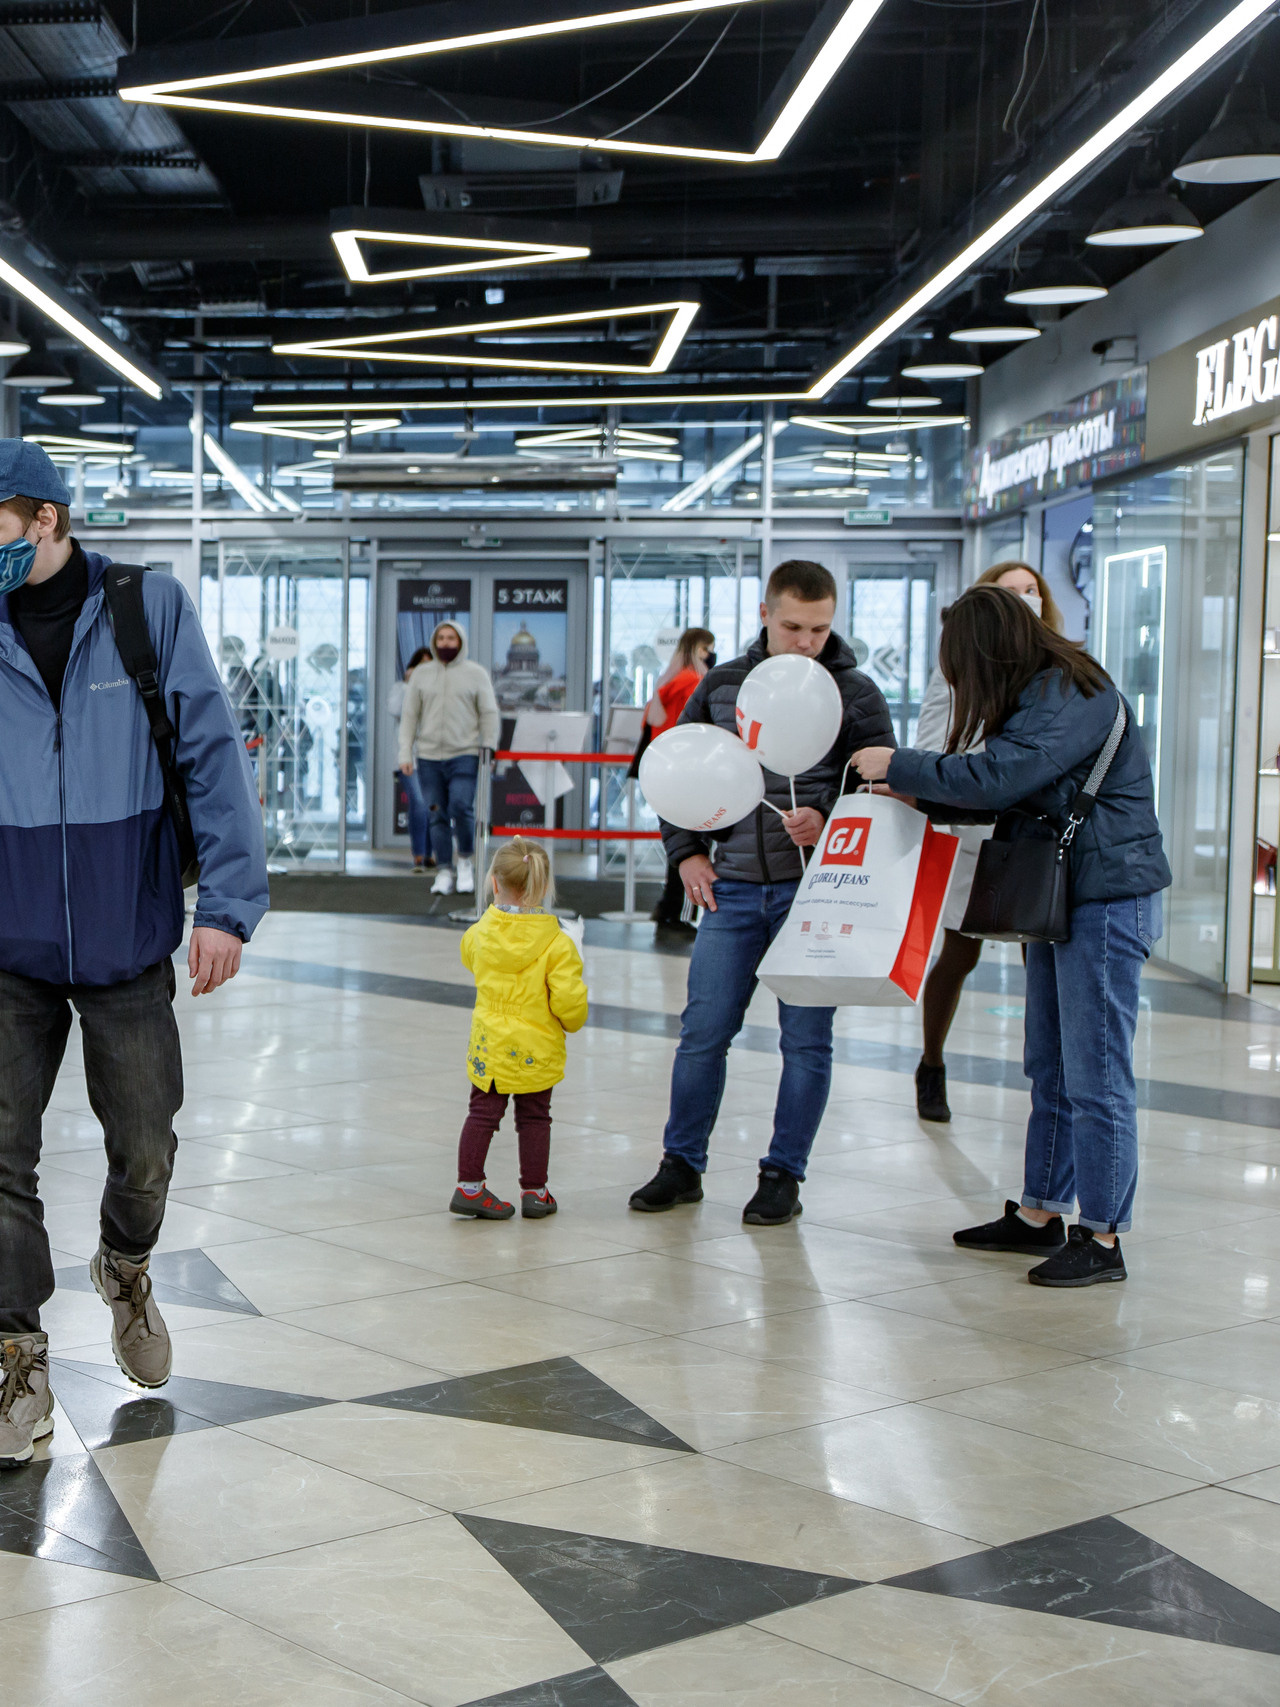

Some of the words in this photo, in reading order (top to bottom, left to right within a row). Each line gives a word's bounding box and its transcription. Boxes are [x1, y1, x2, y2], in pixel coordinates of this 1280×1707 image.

[1192, 314, 1280, 427] ELEG
[1050, 408, 1116, 484] красоты
[497, 589, 510, 604] 5
[513, 588, 564, 604] ЭТАЖ
[97, 678, 129, 690] Columbia
[826, 827, 865, 855] GJ
[807, 872, 839, 889] GLORIA
[833, 873, 871, 889] JEANS
